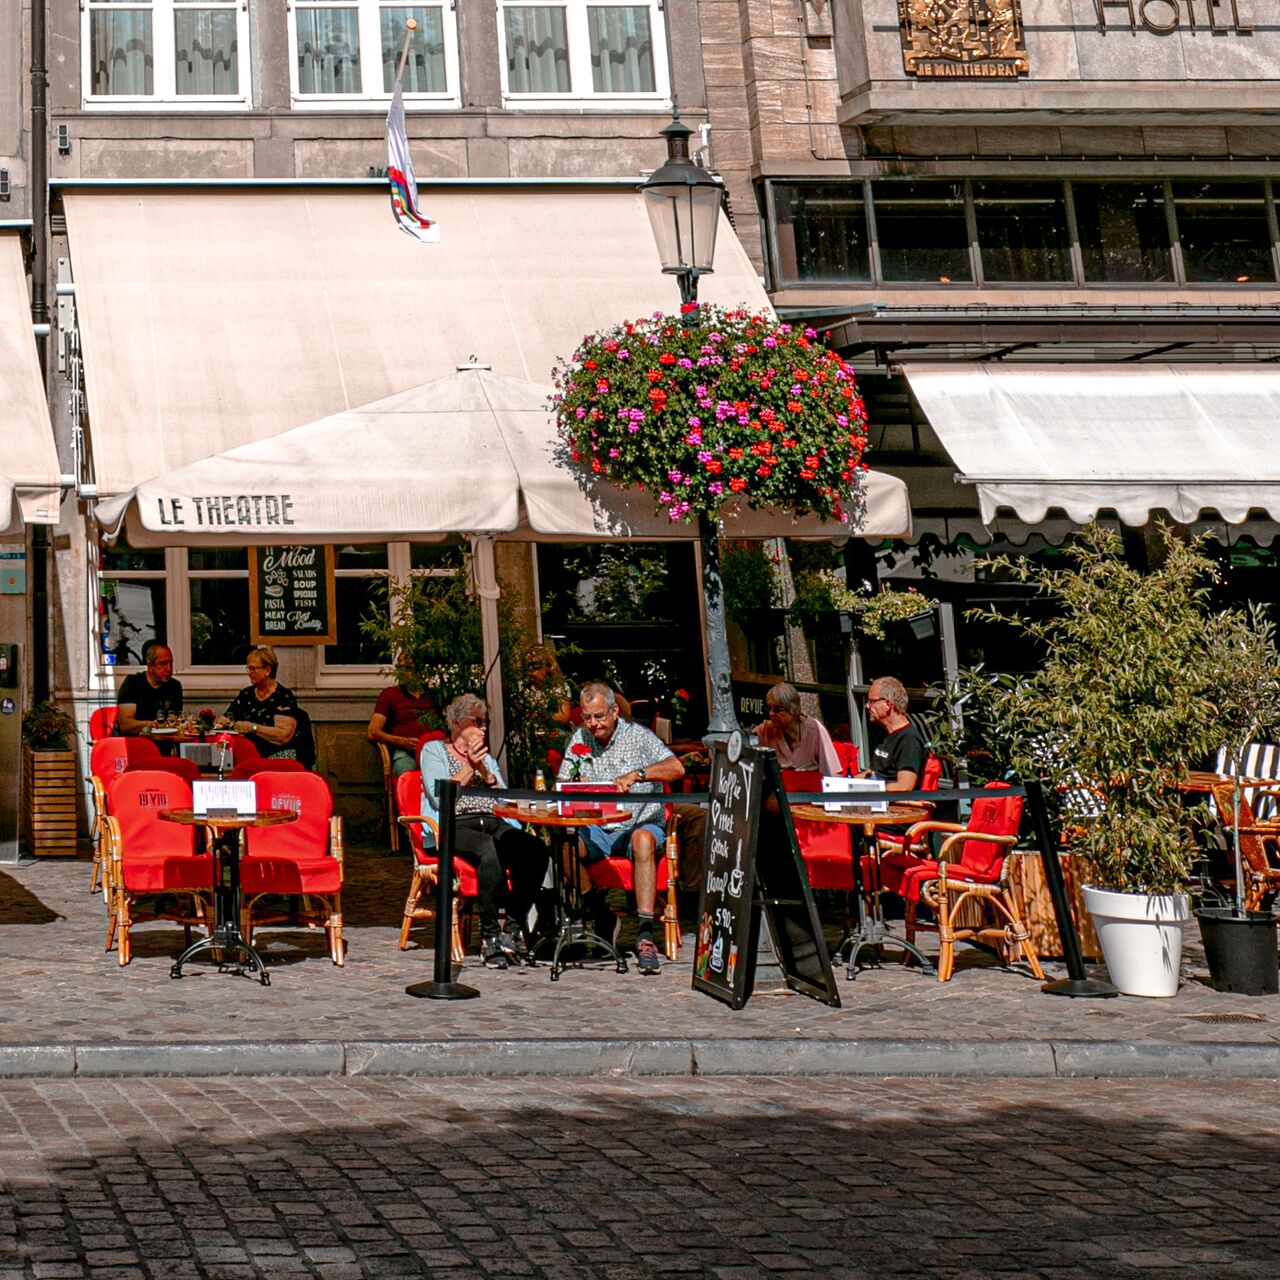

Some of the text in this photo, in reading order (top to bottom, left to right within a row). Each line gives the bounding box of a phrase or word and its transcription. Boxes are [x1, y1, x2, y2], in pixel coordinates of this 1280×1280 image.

[934, 63, 1018, 77] MAINTIENDRAI
[157, 494, 295, 526] LE THEATRE
[263, 548, 316, 572] Mood
[292, 569, 317, 578] SALADS
[293, 580, 317, 589] SOUP
[293, 590, 318, 598] SPECIALS
[264, 599, 285, 609] PASTA
[294, 599, 316, 607] FISH
[264, 611, 286, 619] MEAT
[265, 621, 286, 630] BREAD
[740, 696, 764, 715] REVUE
